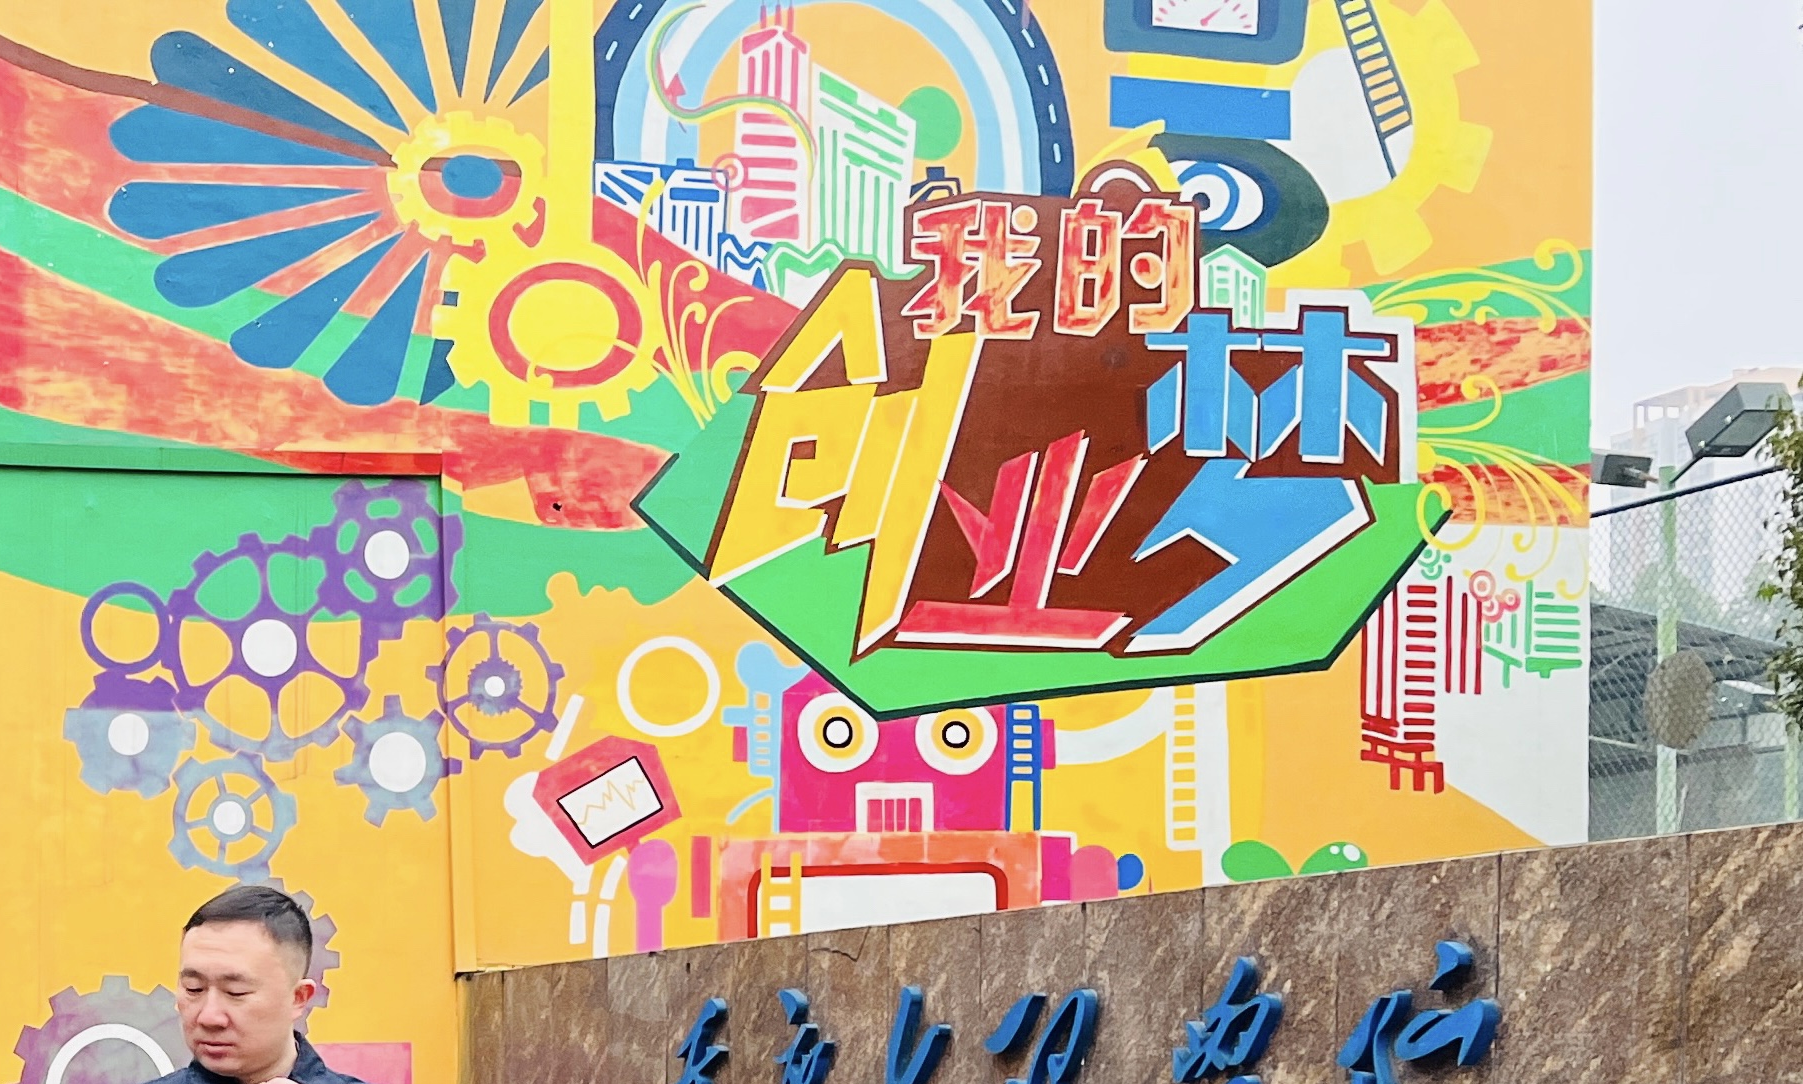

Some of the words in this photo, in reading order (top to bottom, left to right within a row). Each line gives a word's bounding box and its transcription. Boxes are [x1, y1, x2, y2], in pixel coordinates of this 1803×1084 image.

[902, 199, 1196, 339] 我的
[709, 269, 1390, 655] 创业梦
